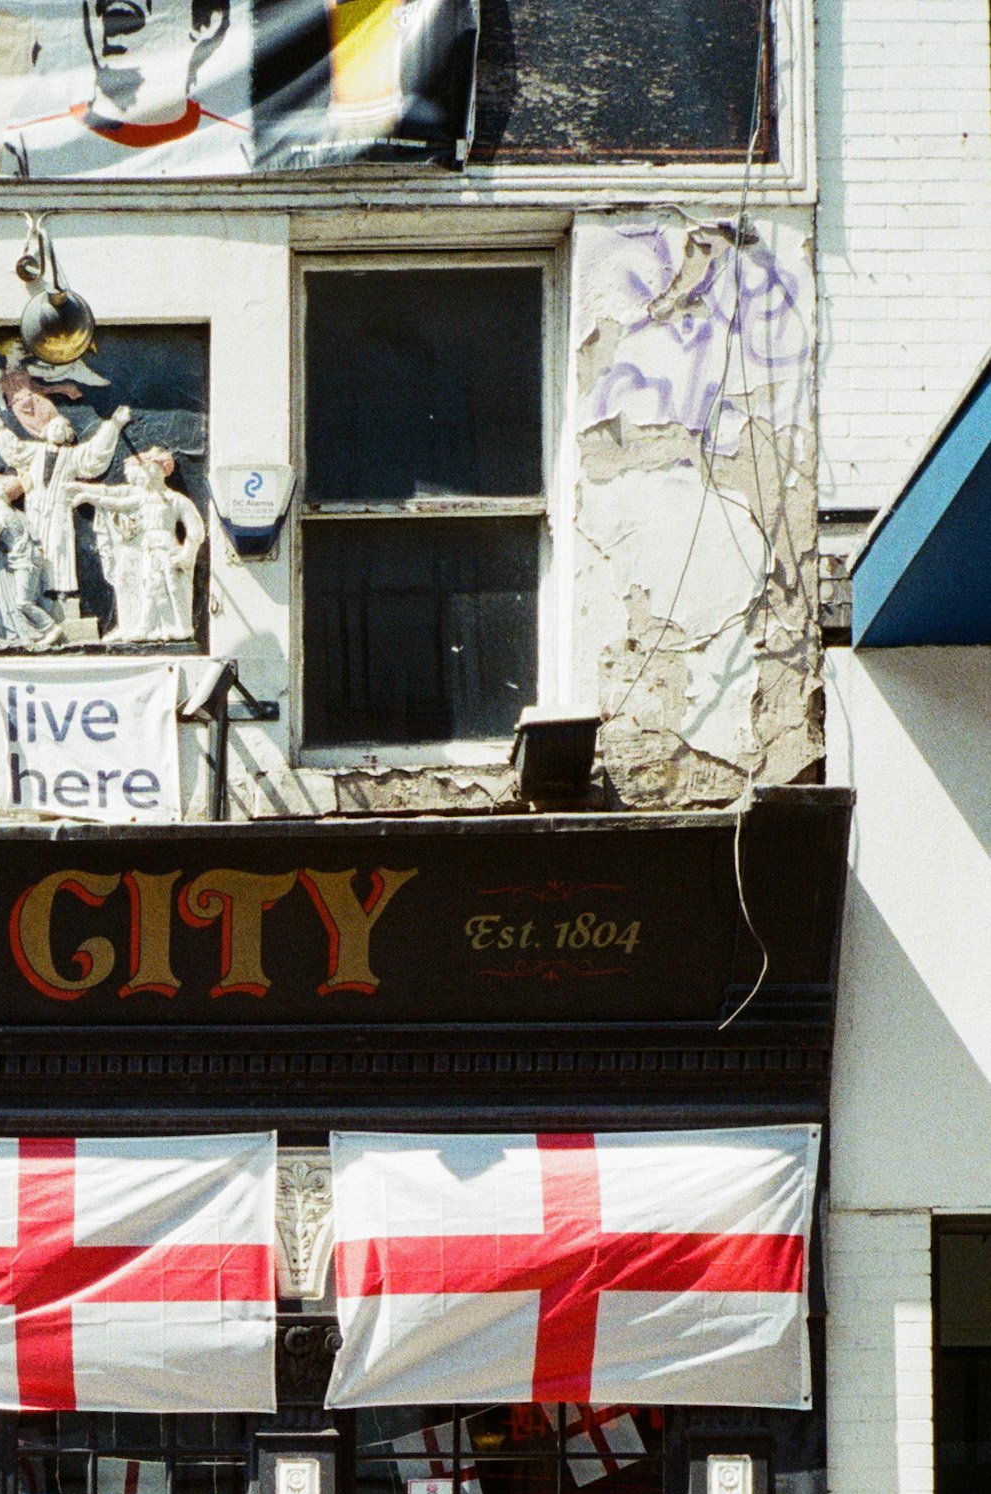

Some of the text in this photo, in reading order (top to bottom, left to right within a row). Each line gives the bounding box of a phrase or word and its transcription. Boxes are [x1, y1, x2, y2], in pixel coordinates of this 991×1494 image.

[7, 684, 119, 742] live
[10, 753, 160, 808] here
[10, 867, 419, 1000] CITY
[463, 911, 643, 955] Est. 1804
